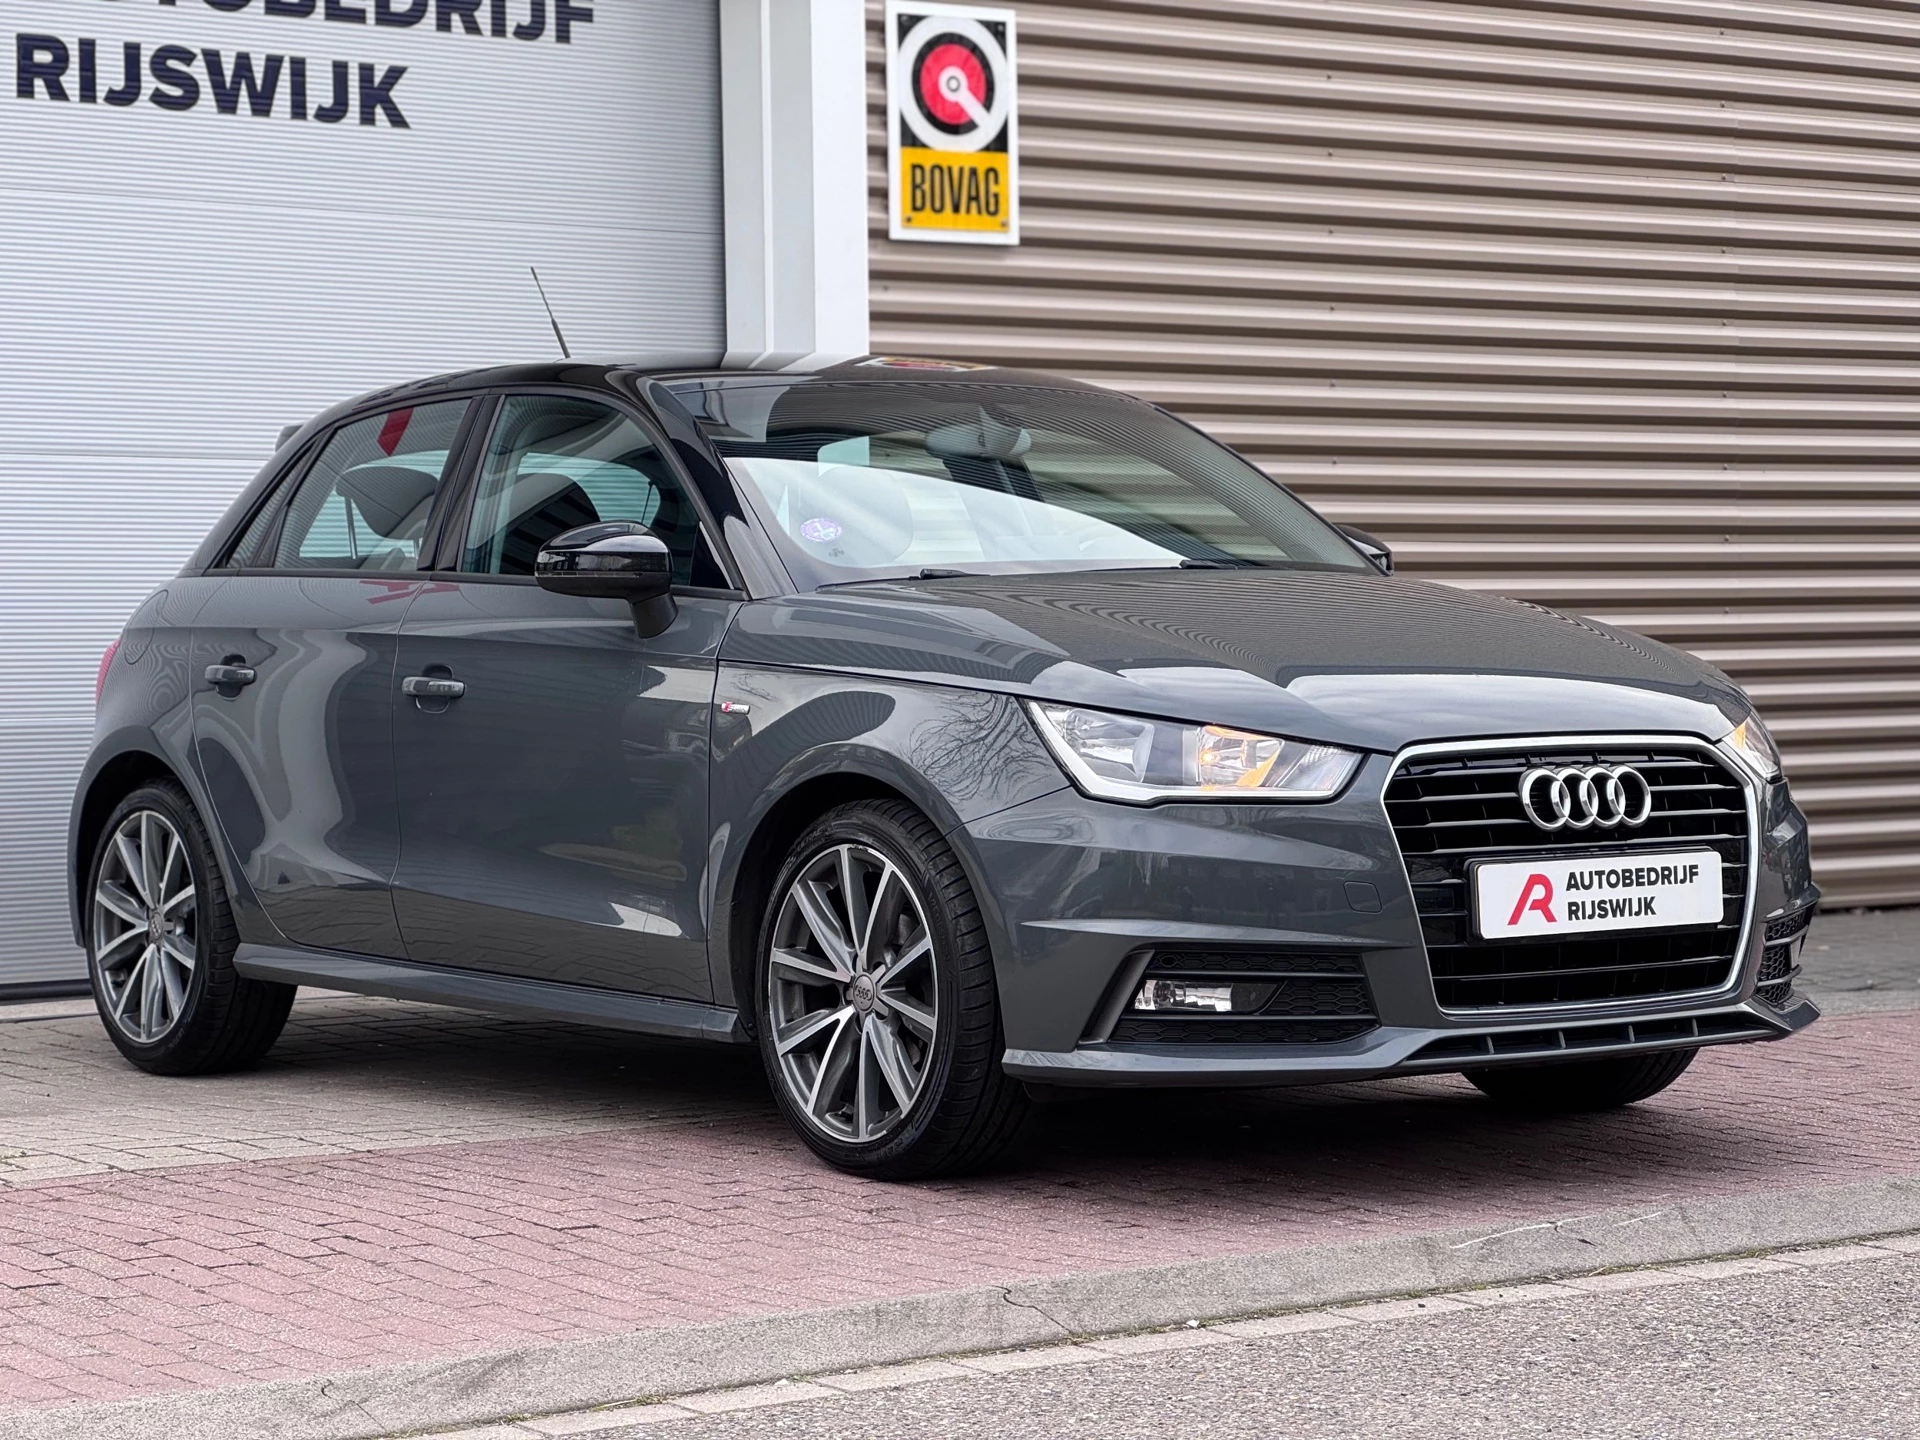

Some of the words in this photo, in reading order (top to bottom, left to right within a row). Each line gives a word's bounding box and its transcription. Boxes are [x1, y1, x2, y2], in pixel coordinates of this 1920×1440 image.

[16, 33, 411, 129] RIJSWIJK
[910, 163, 1000, 218] BOVAG
[1566, 864, 1700, 892] AUTOBEDRIJF
[1567, 896, 1657, 922] RIJSWIJK
